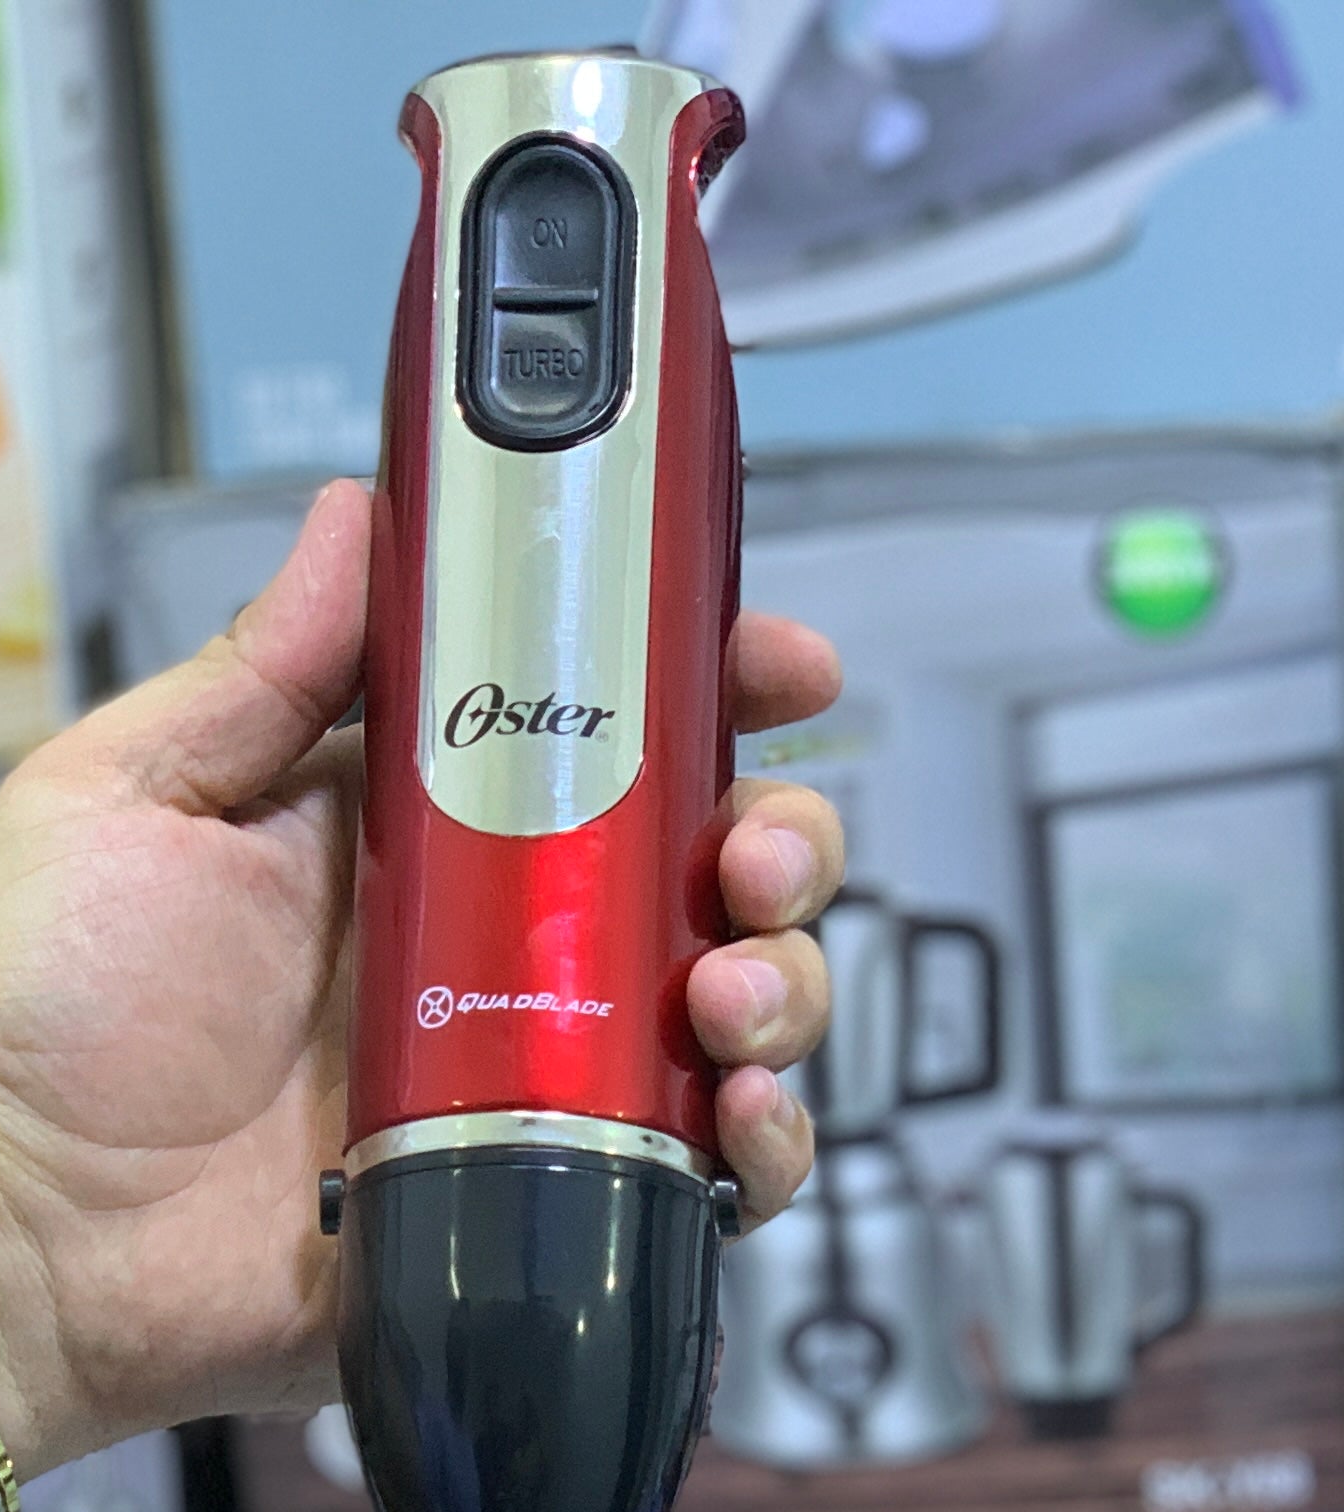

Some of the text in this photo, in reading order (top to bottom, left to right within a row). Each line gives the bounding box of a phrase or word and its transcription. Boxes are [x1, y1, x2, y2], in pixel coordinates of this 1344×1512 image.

[530, 217, 568, 248] ON
[503, 348, 587, 380] TURBO
[444, 682, 616, 749] Oster
